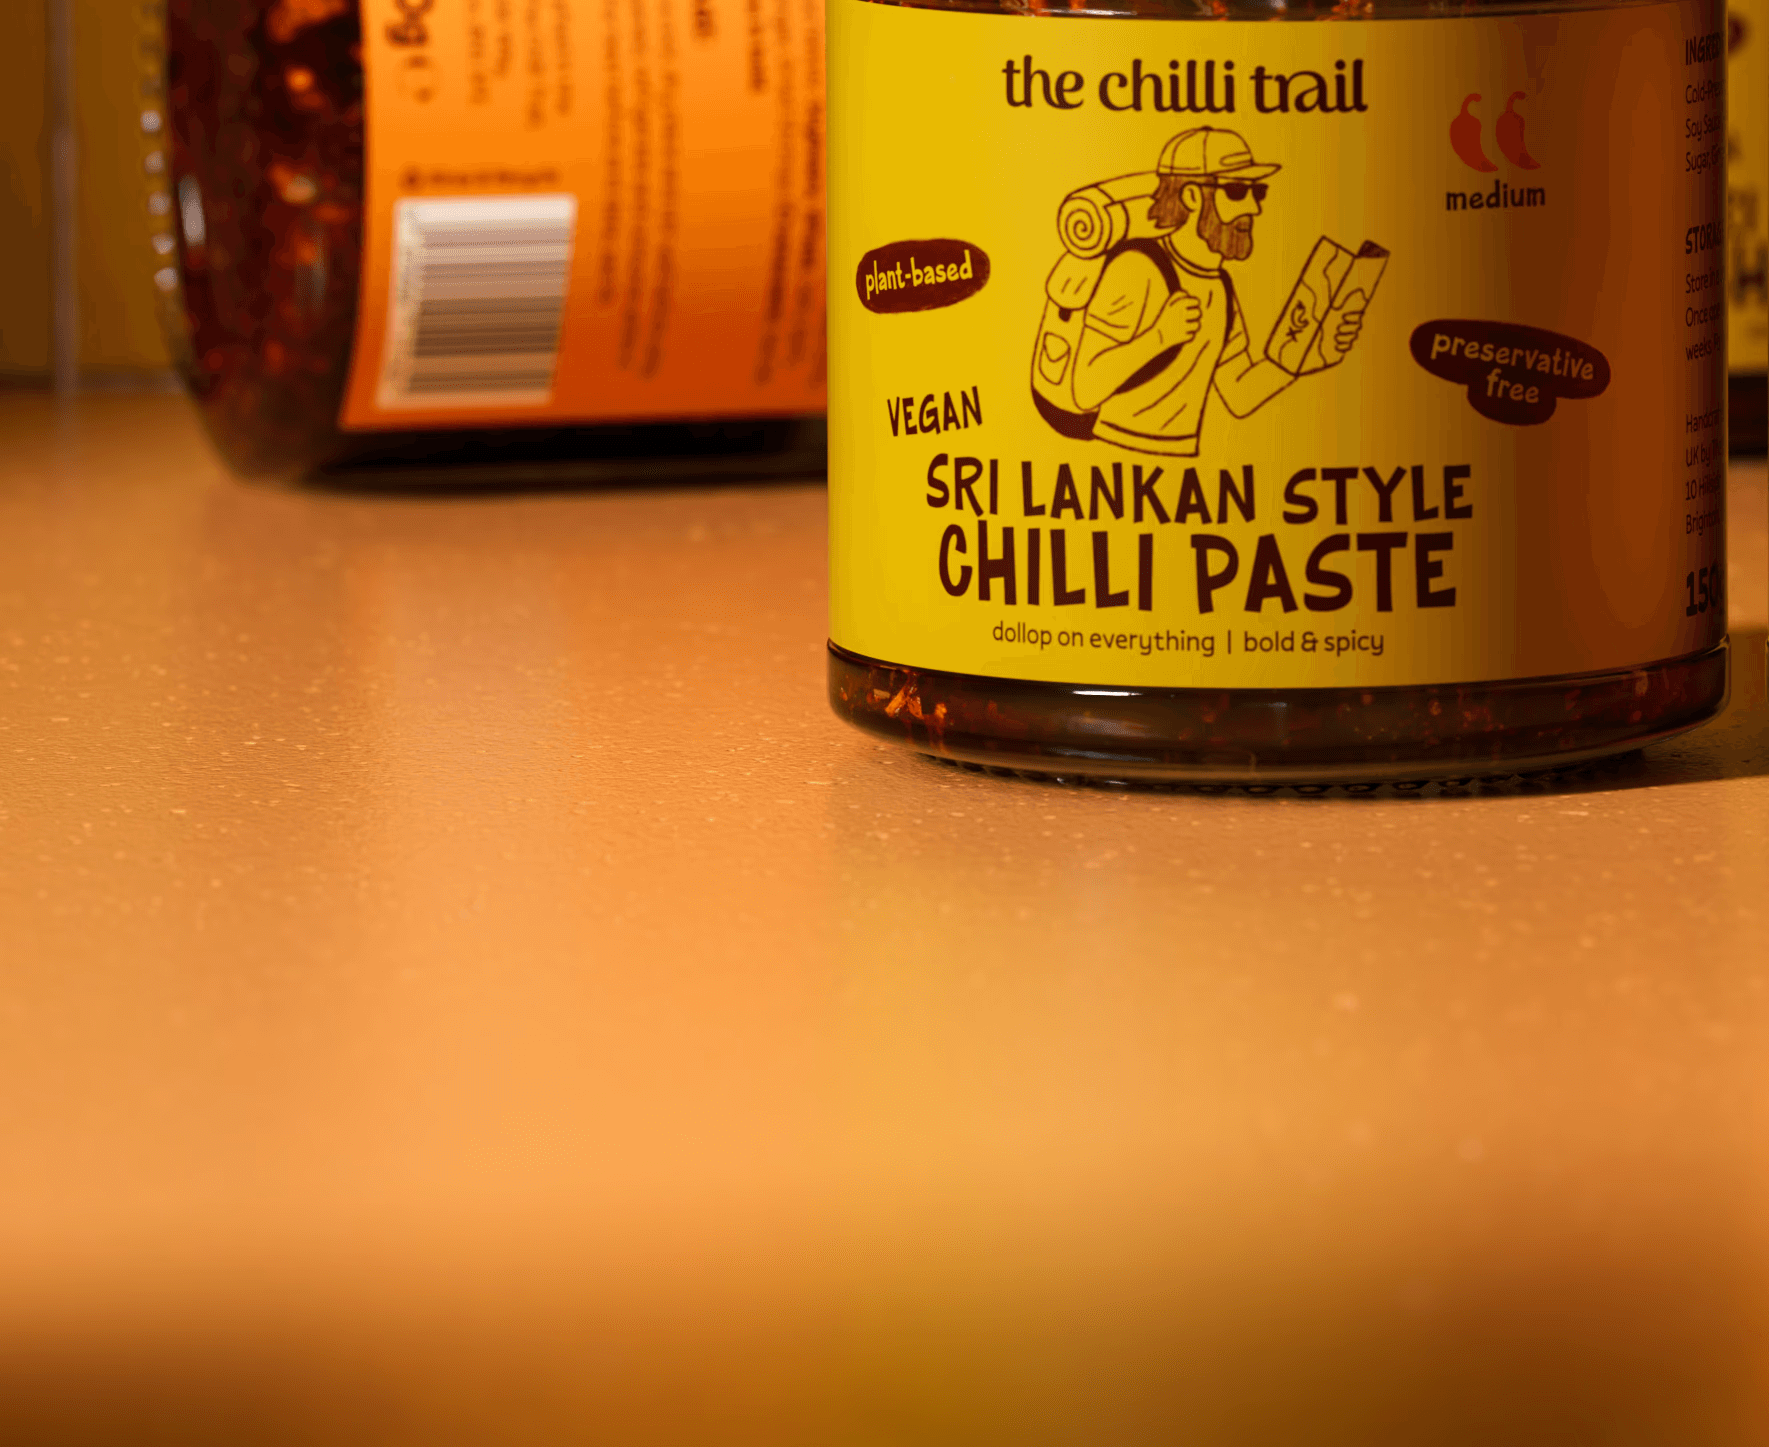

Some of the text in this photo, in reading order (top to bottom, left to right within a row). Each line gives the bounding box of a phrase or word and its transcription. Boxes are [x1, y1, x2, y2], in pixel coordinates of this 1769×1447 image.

[1002, 55, 1368, 114] the chilli trail
[1446, 179, 1545, 211] medium
[866, 250, 973, 300] plant-based
[1430, 333, 1593, 380] preservative
[1486, 367, 1539, 403] free
[887, 386, 982, 437] VEGAN
[926, 453, 1473, 525] SRI LANKAN STYLE
[1685, 478, 1697, 501] 10
[939, 519, 1456, 614] CHILLI PASTE
[1686, 560, 1722, 617] 150
[993, 621, 1052, 649] dollop
[1058, 631, 1083, 646] on
[1090, 630, 1214, 657] everything
[1245, 631, 1294, 652] bold
[1301, 631, 1318, 652] &
[1325, 630, 1383, 657] spicy
